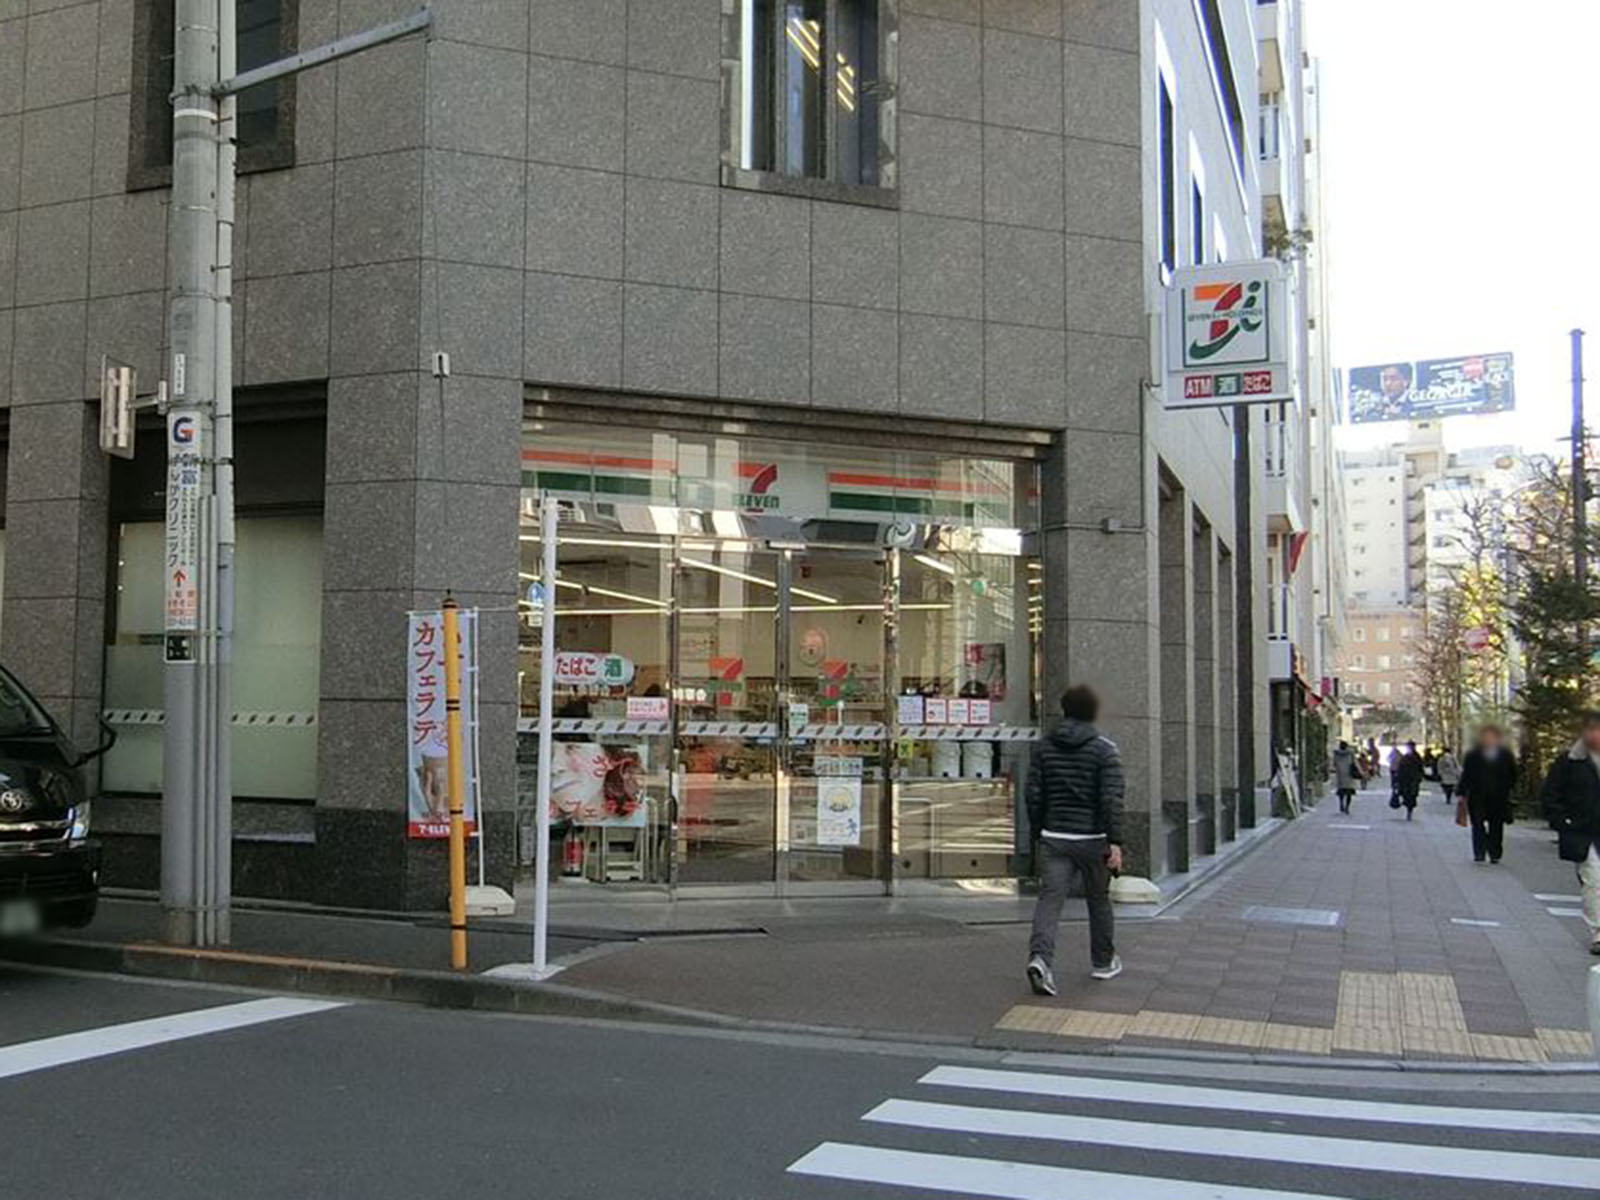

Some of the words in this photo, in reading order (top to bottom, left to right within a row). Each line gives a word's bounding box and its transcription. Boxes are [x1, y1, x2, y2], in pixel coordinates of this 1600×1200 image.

[1186, 377, 1212, 397] ATM
[555, 658, 596, 676] たばこ
[604, 658, 622, 677] 酒
[413, 621, 437, 744] カフェラテ
